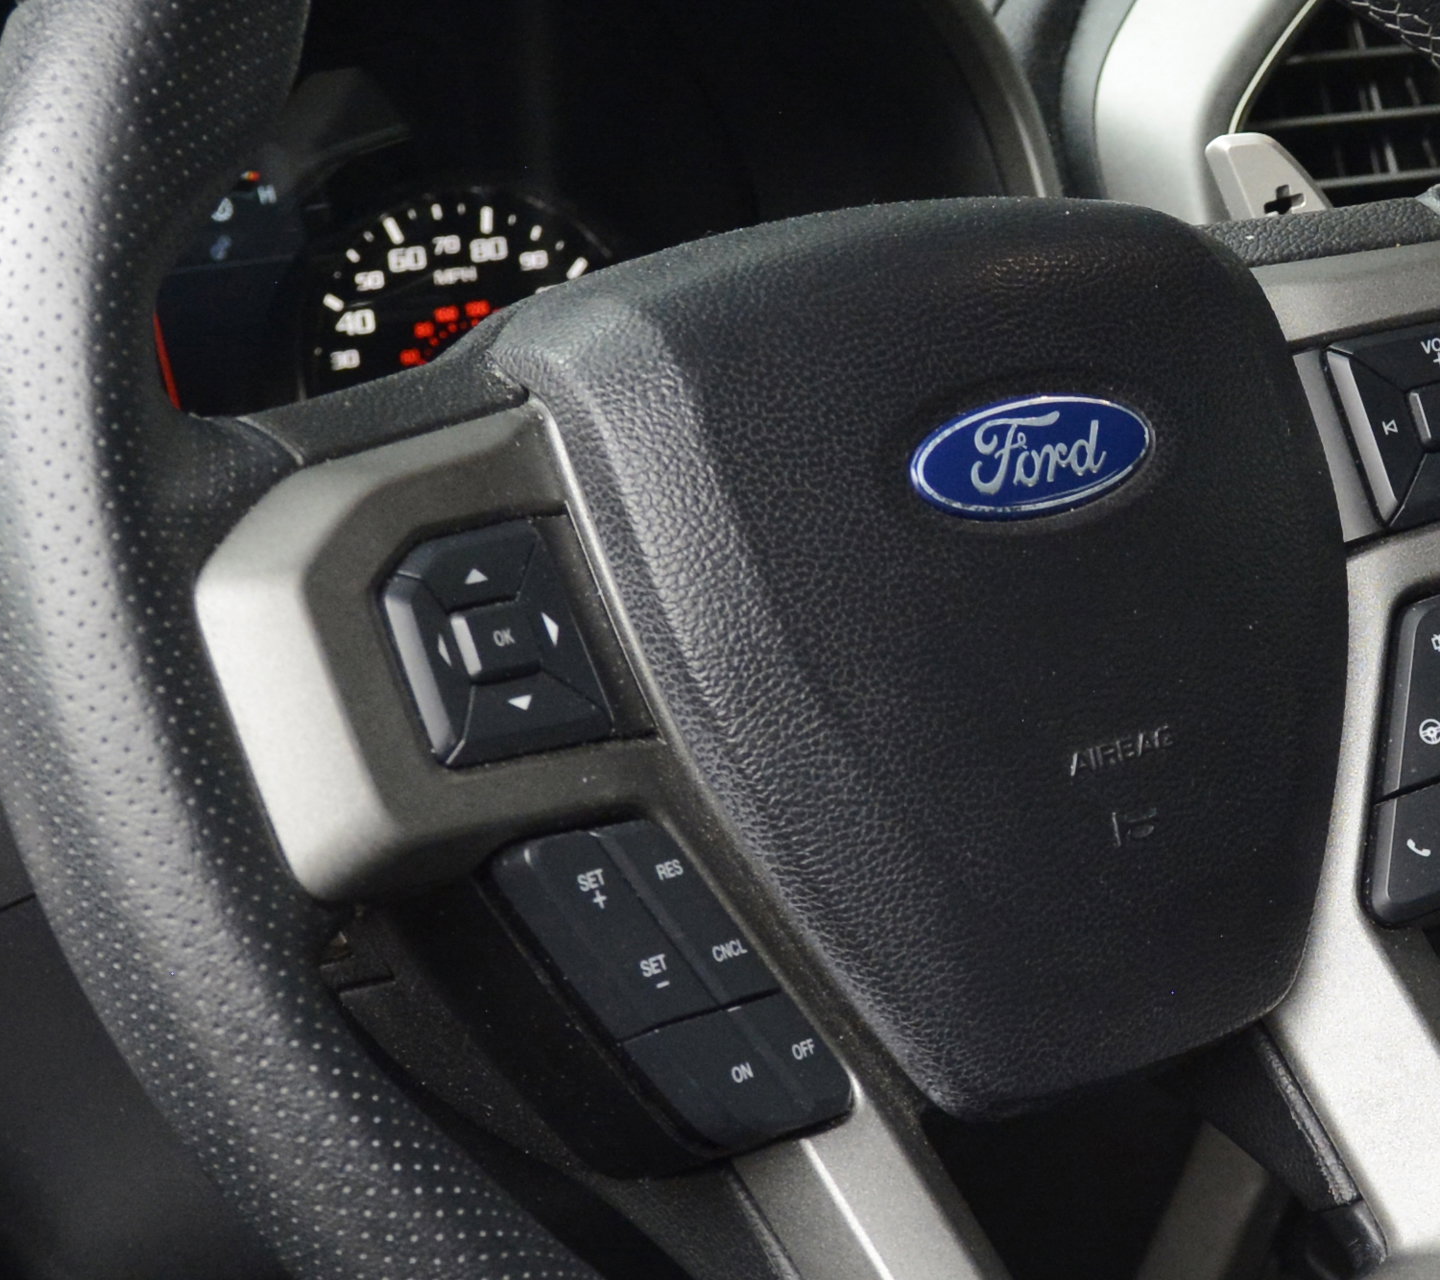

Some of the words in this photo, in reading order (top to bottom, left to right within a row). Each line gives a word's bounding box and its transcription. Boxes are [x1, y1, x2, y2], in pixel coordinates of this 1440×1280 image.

[432, 234, 461, 255] 70
[469, 236, 509, 263] 80
[387, 245, 427, 273] 60
[354, 269, 385, 291] 50
[432, 265, 479, 286] MPH
[335, 308, 376, 336] 40
[970, 410, 1107, 495] Ford
[492, 629, 516, 647] OK
[576, 868, 605, 892] SET
[655, 859, 684, 881] RES
[711, 938, 748, 963] CNCL
[639, 954, 668, 978] SET
[791, 1038, 816, 1060] OFF
[730, 1061, 754, 1084] ON
